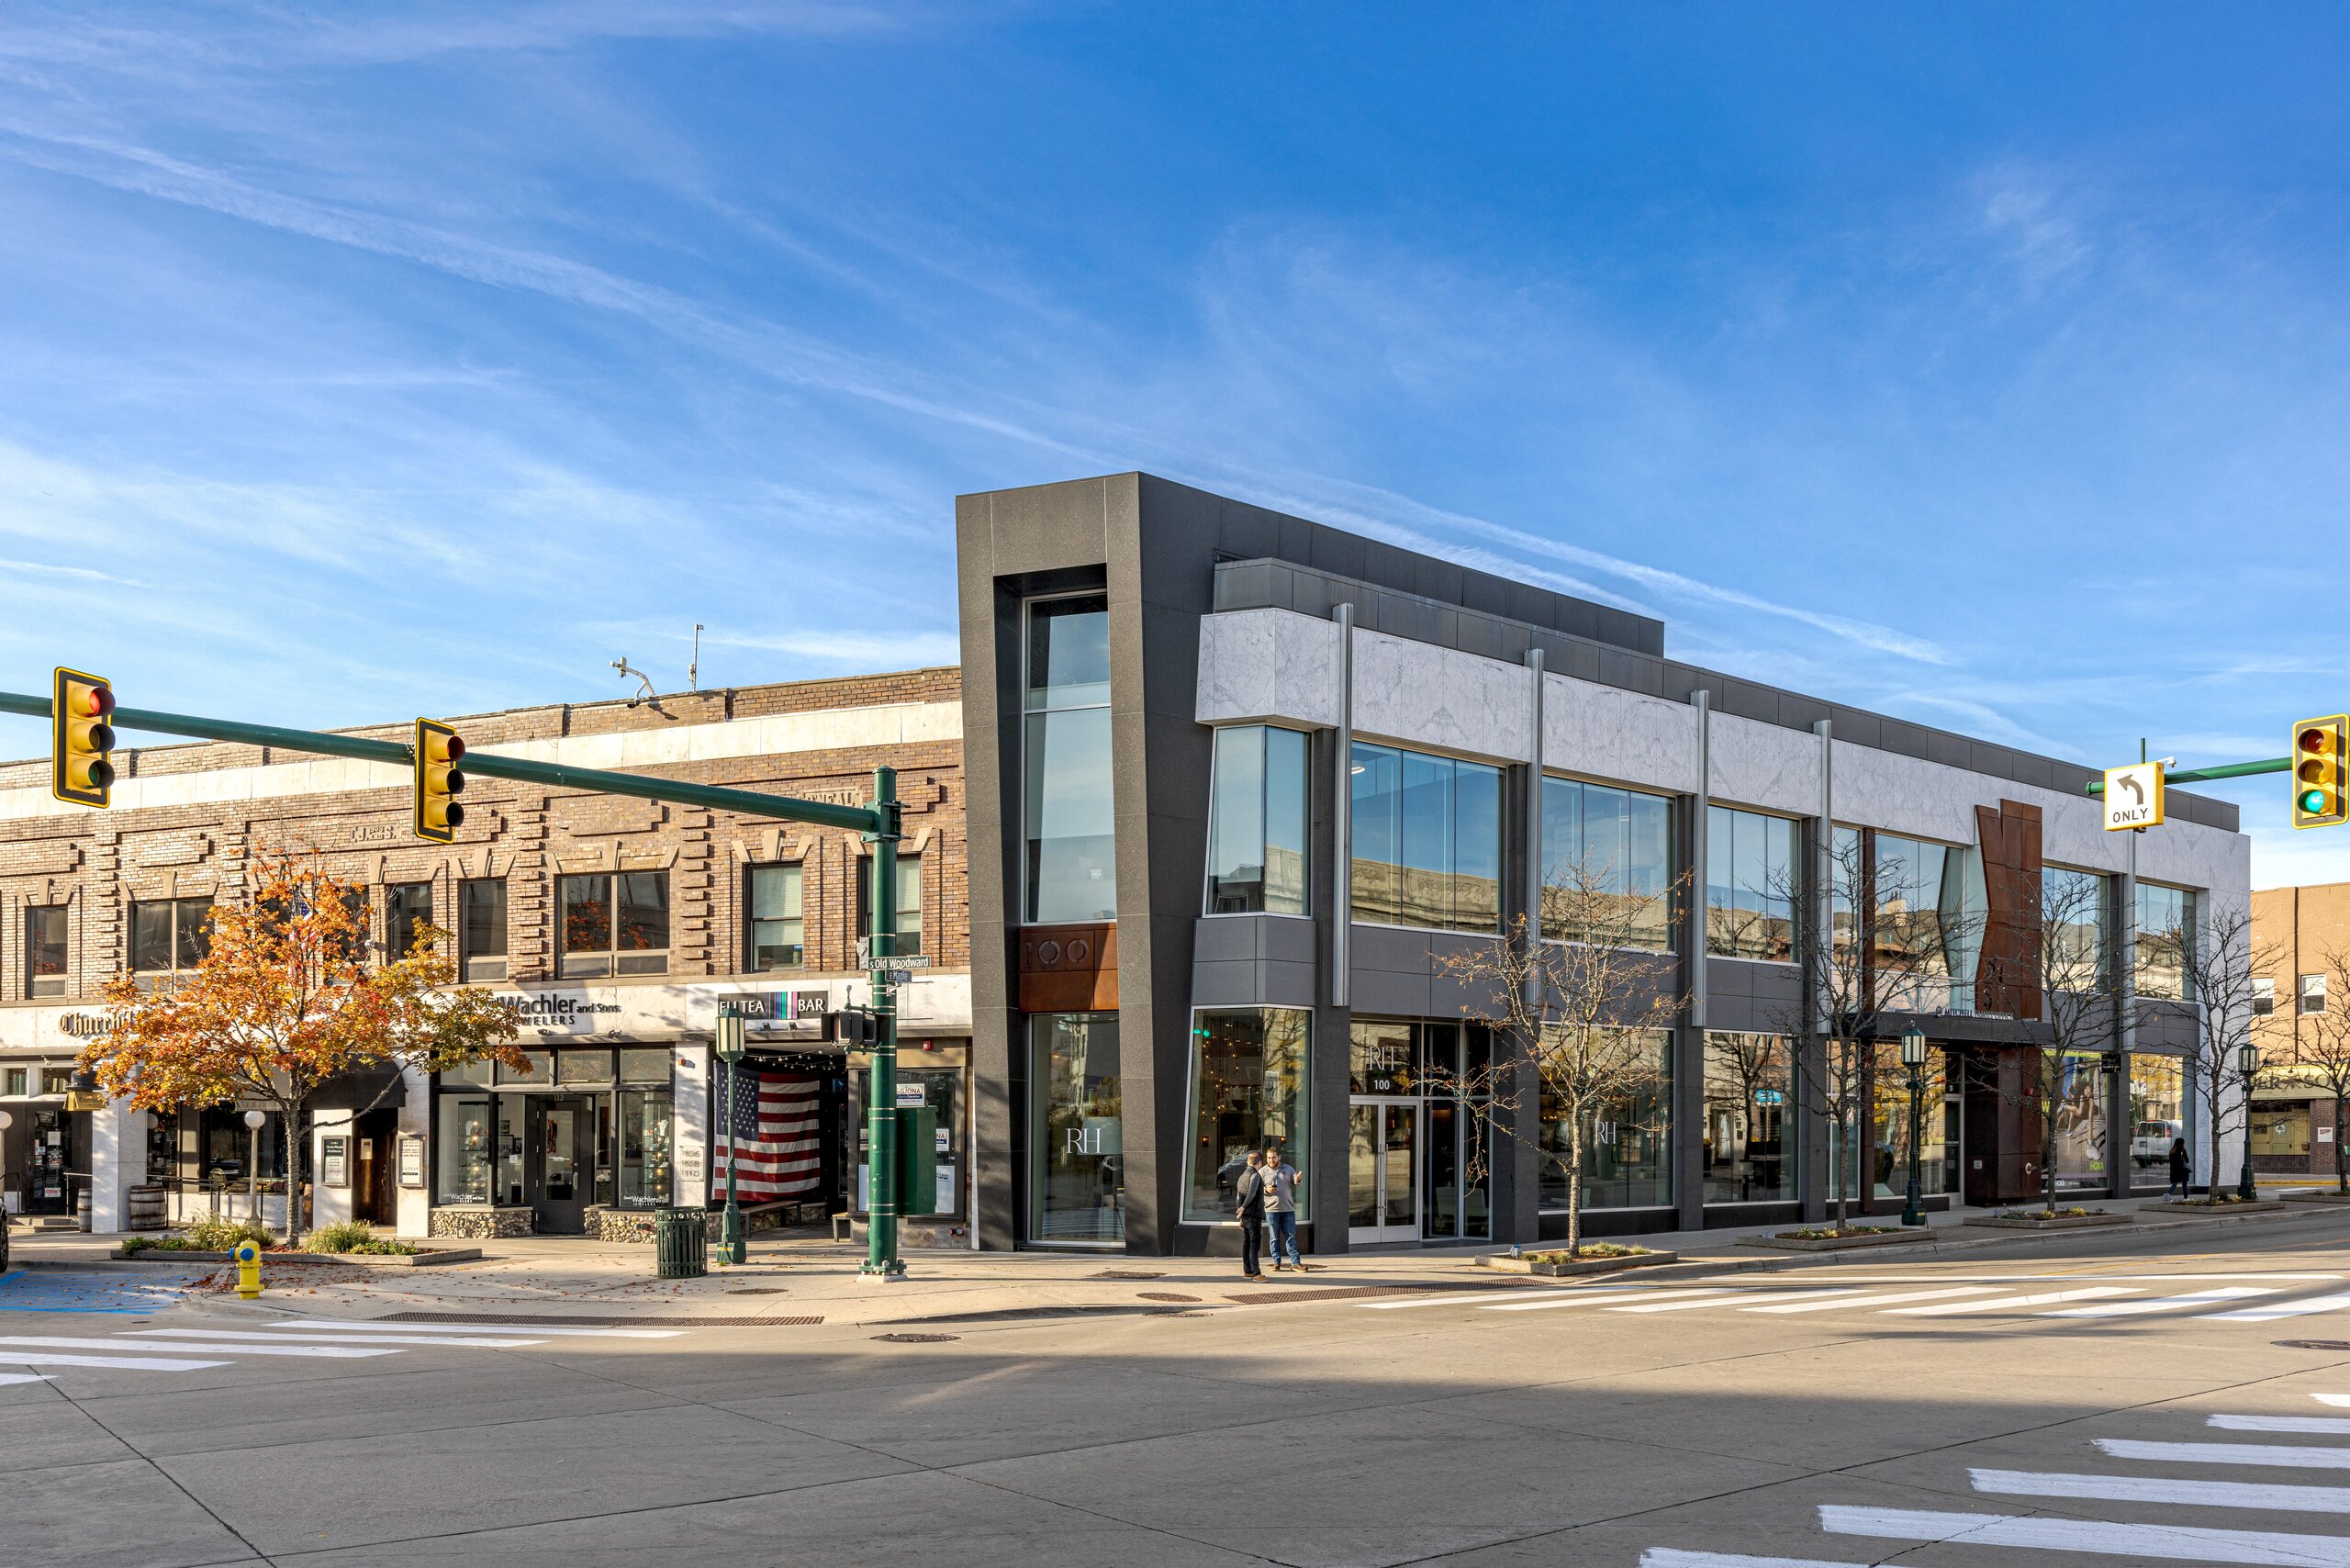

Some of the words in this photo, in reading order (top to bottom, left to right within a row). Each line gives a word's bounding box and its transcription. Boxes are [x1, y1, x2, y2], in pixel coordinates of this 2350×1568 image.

[2113, 808, 2148, 823] ONLY
[1024, 939, 1090, 965] 100
[875, 958, 887, 969] Old
[889, 957, 929, 969] Woodward
[893, 970, 909, 982] Maple
[500, 994, 576, 1014] Wachler
[576, 1002, 595, 1013] and
[597, 1002, 621, 1013] Sons
[740, 999, 765, 1013] TEA
[798, 998, 825, 1012] BAR
[1944, 1008, 1974, 1018] MITCHELL
[1367, 1047, 1395, 1070] RH
[1373, 1079, 1390, 1090] 100
[1066, 1127, 1102, 1154] RH
[1594, 1121, 1617, 1145] RH
